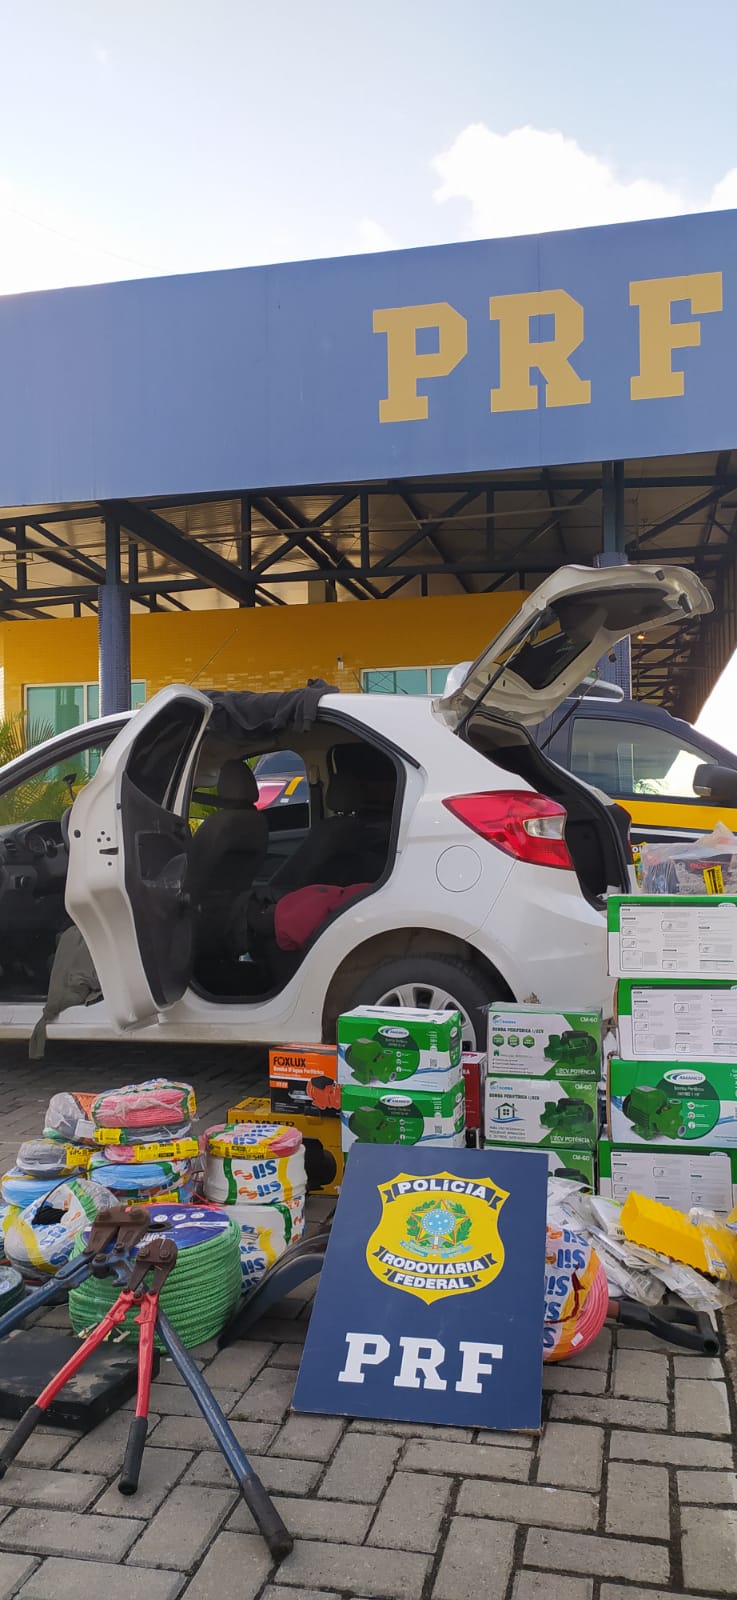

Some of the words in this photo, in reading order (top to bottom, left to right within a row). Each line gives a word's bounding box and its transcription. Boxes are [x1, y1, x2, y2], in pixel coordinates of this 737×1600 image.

[373, 271, 723, 423] PRF
[273, 1056, 306, 1068] FOXLUX
[252, 1160, 277, 1180] Sil
[257, 1180, 282, 1197] Sil
[397, 1178, 489, 1200] POLÍCIA
[381, 1252, 485, 1275] RODOVIÁRIA
[557, 1249, 586, 1269] Sil
[393, 1272, 470, 1290] FEDERAL
[545, 1275, 570, 1297] Si
[337, 1332, 504, 1394] PRF
